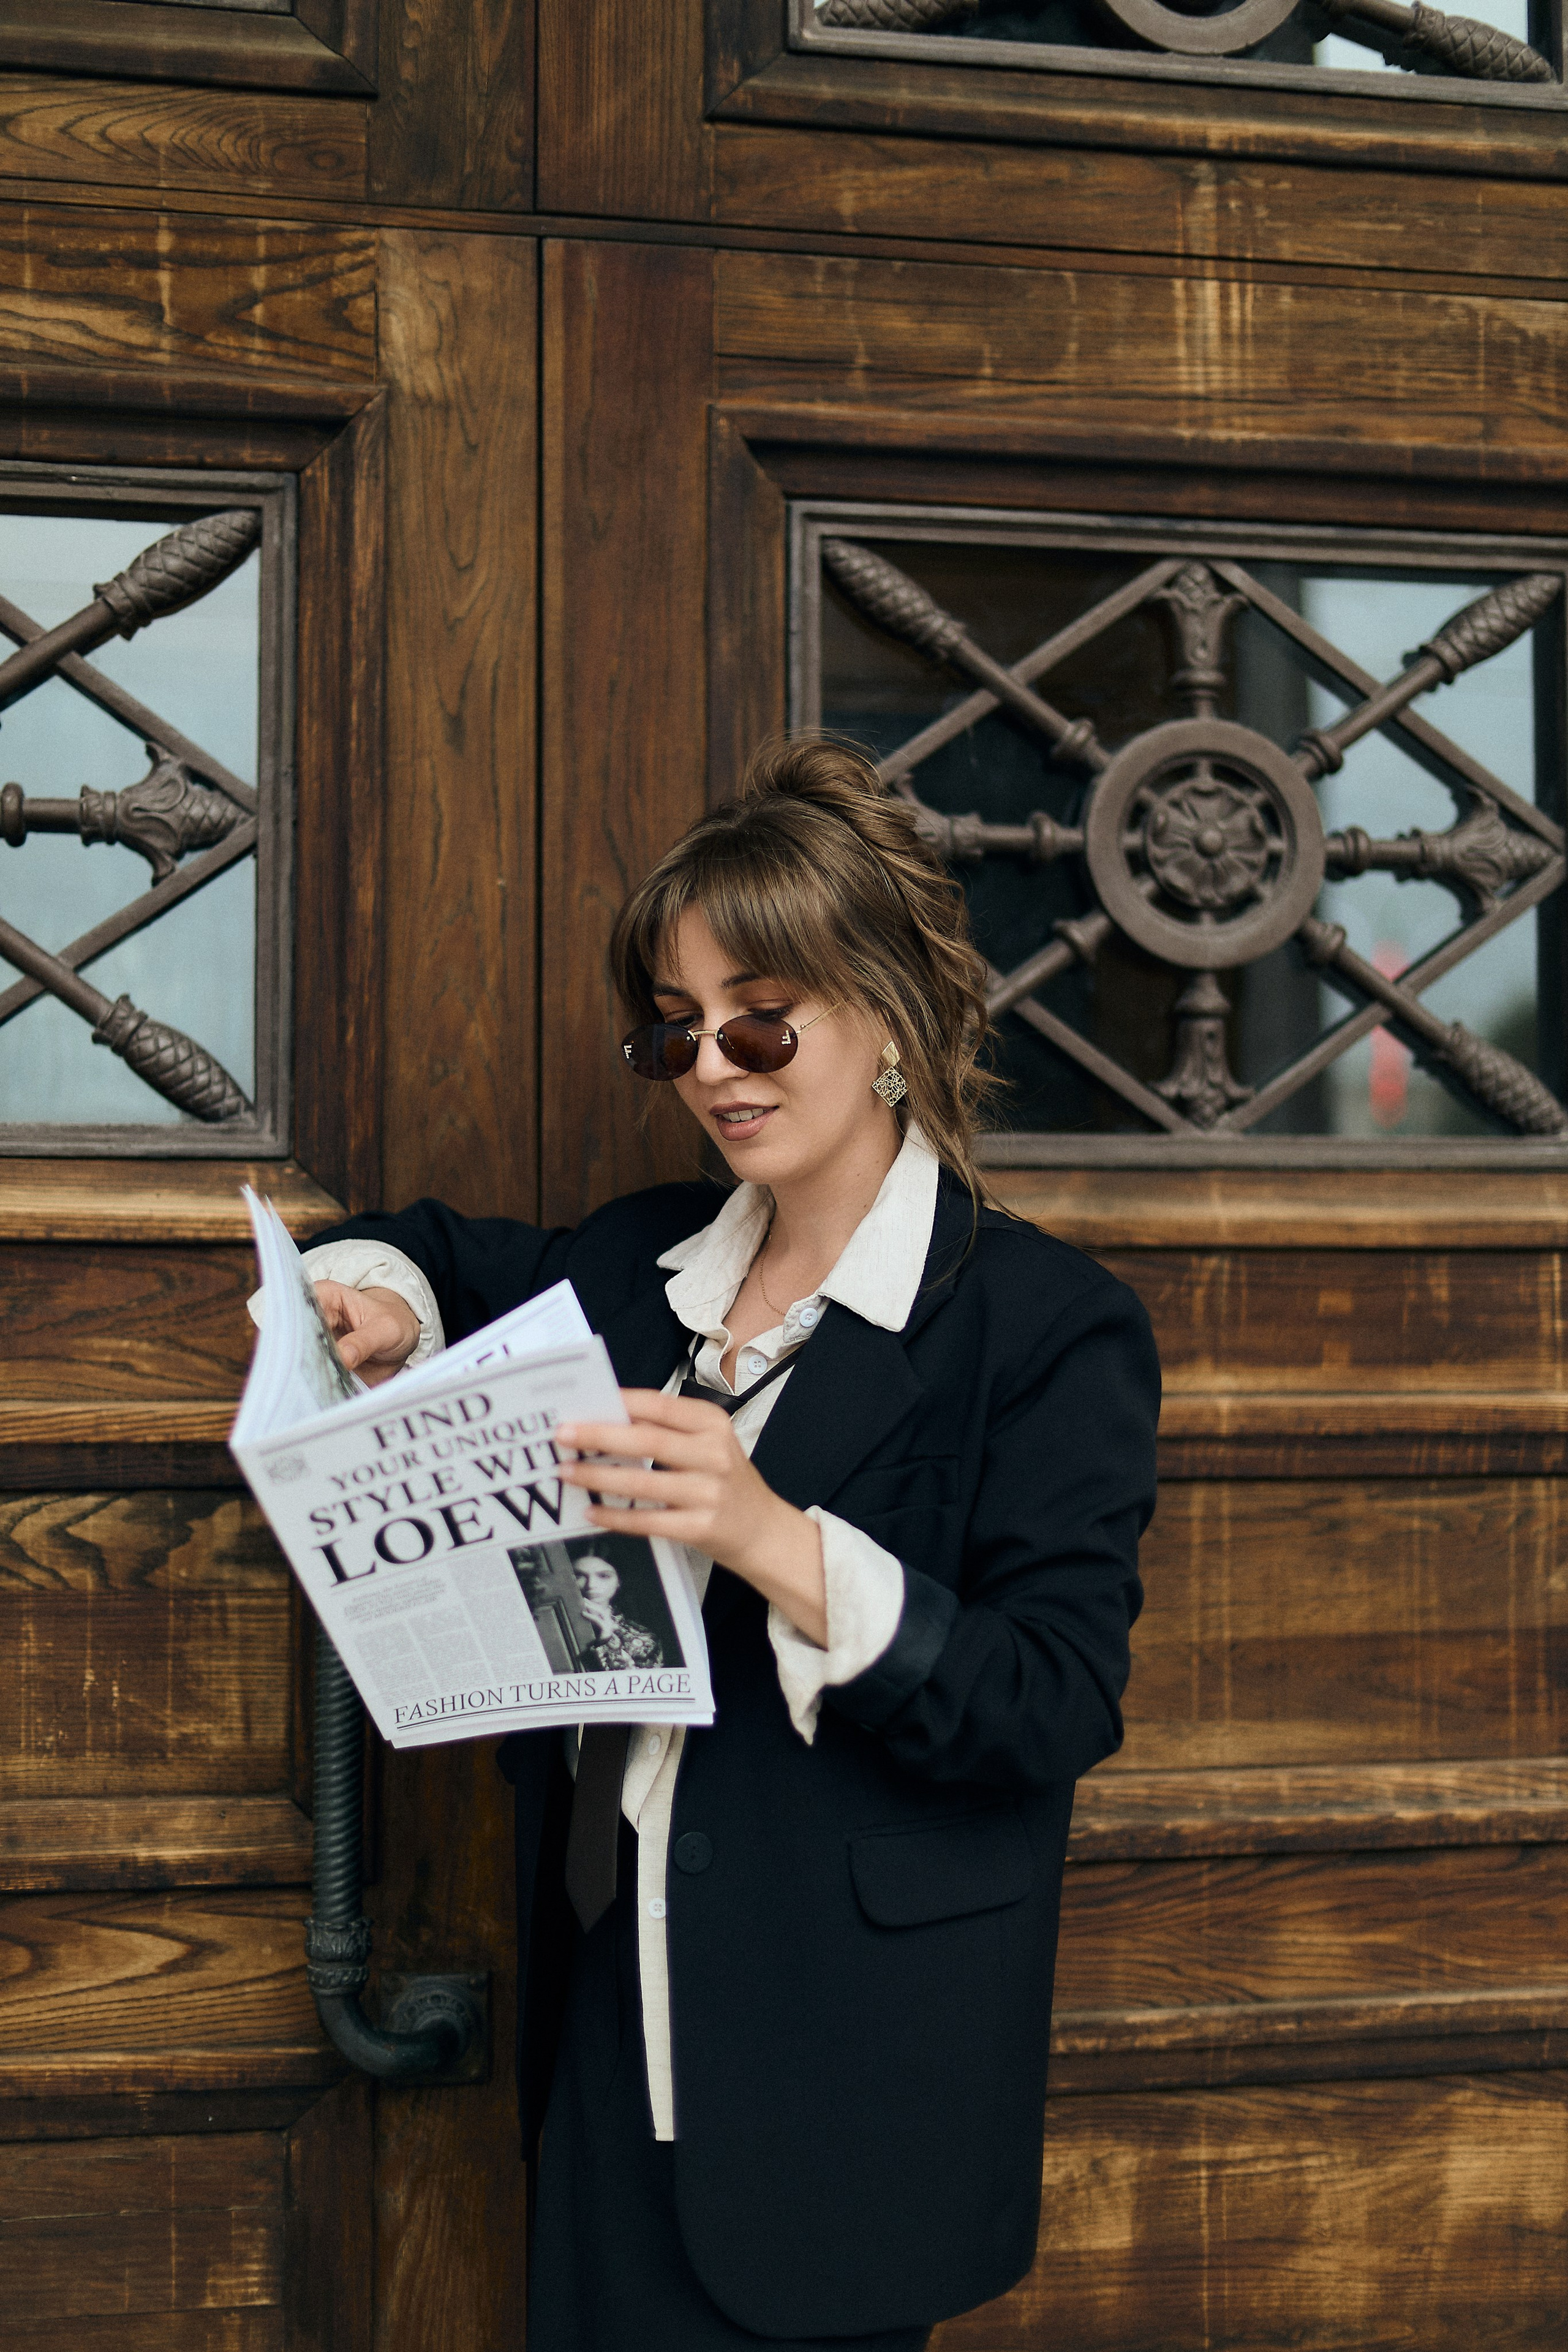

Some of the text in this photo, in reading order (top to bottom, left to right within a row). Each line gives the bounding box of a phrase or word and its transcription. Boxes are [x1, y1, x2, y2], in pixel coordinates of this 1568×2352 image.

[372, 1392, 493, 1450] FIND
[329, 1449, 423, 1491] YOUR
[309, 1466, 464, 1536] STYLE
[393, 1673, 692, 1724] FASHION TURNS A PAGE
